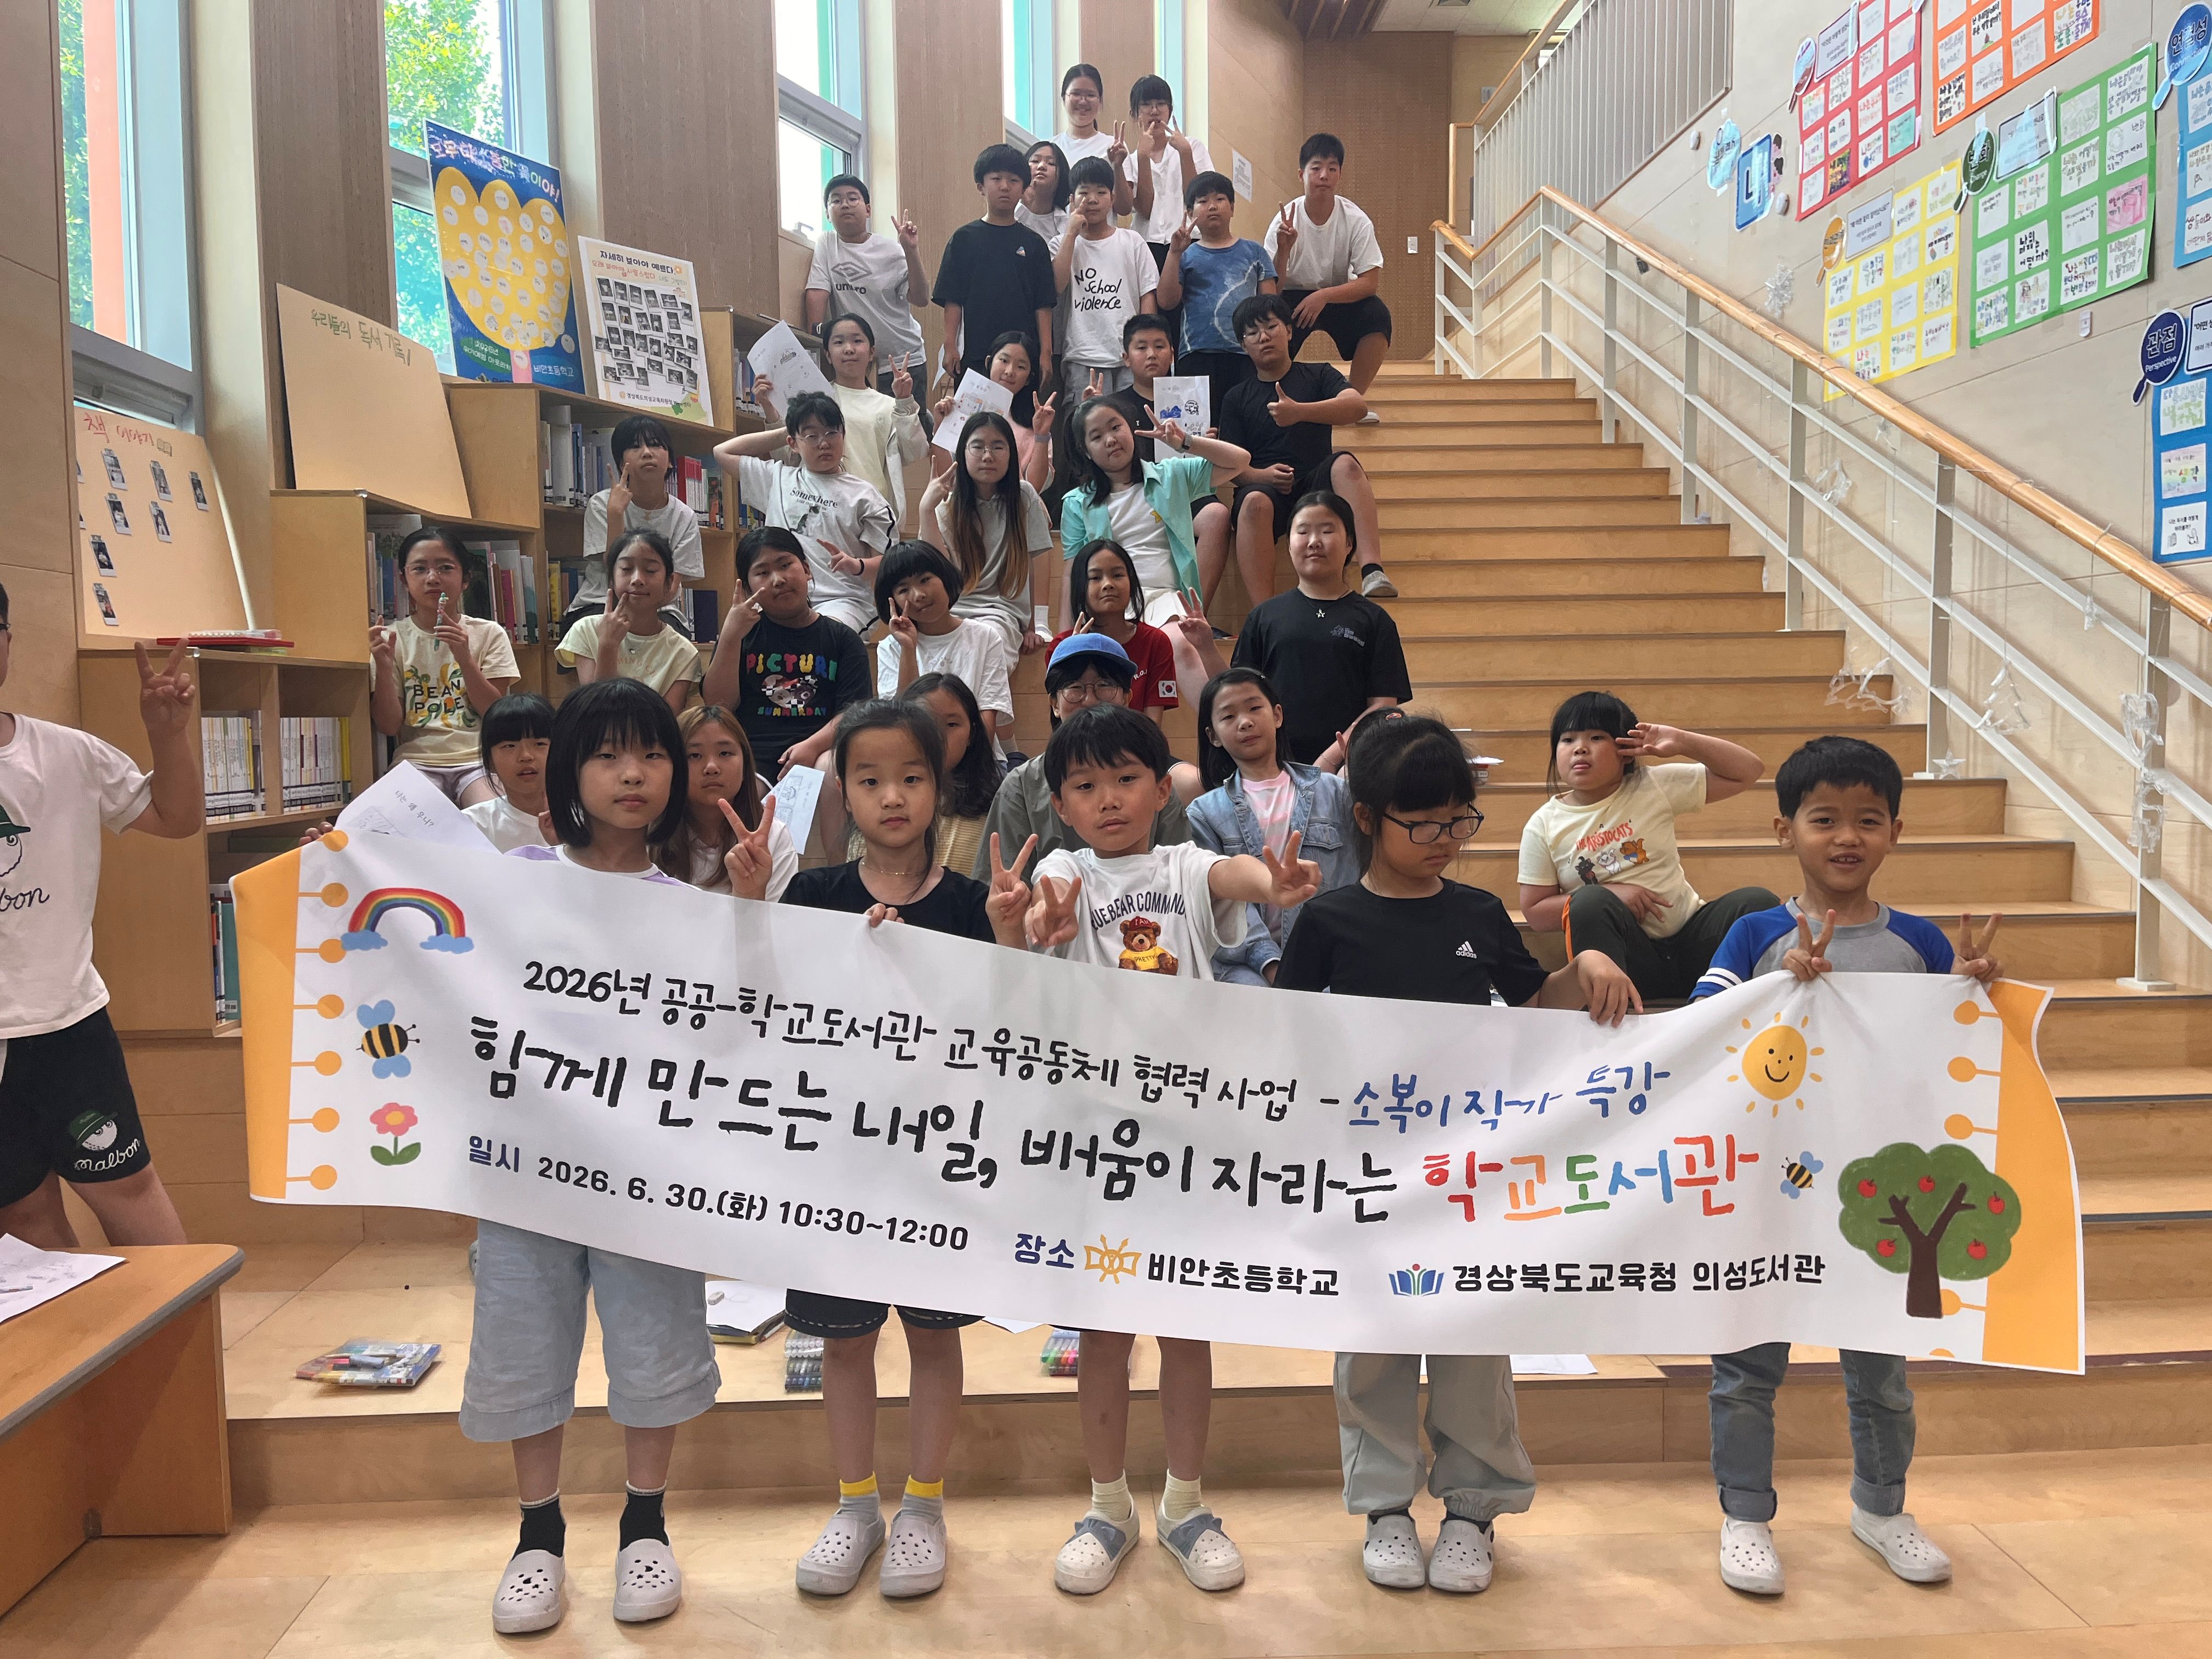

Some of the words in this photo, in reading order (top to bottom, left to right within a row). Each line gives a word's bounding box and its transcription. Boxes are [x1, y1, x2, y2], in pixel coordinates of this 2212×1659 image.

[600, 250, 624, 263] 자세히
[626, 256, 650, 268] 보아야
[836, 283, 867, 295] umro
[1074, 268, 1097, 285] NO
[311, 309, 352, 340] 우리들의
[358, 321, 383, 352] 독서
[2146, 323, 2177, 359] 관점
[2145, 356, 2177, 373] Perspective
[83, 412, 110, 443] 책
[116, 425, 155, 447] 이야기
[414, 679, 461, 698] BEAN
[415, 697, 464, 714] POLE
[1576, 838, 1587, 851] THE
[1107, 894, 1136, 922] BEAR
[1455, 950, 1477, 959] adidas
[523, 961, 651, 1015] 2026년
[661, 978, 937, 1062] 공공-학교도서관
[944, 1028, 1120, 1087] 교육공동체
[1133, 1054, 1210, 1109] 협력
[1217, 1077, 1297, 1122] 사업
[1348, 1073, 1451, 1134] 소복이
[1463, 1089, 1563, 1131] 작가
[1576, 1062, 1671, 1118] 특강
[471, 1015, 627, 1108] 함께
[648, 1058, 832, 1152] 만드는
[853, 1099, 997, 1189] 내일,
[1020, 1119, 1194, 1201] 배움이
[1212, 1151, 1397, 1223] 자라는
[1423, 1134, 1759, 1222] 학교도서관
[469, 1136, 520, 1173] 일시
[538, 1156, 616, 1196] 2026.
[628, 1177, 654, 1204] 6.
[665, 1183, 768, 1221] 30.(화)
[779, 1201, 968, 1250] 10:30~12:00
[1014, 1233, 1075, 1269] 장소
[1148, 1253, 1340, 1296] 비안초등학교
[1453, 1262, 1677, 1293] 경상북도교육청
[1692, 1254, 1826, 1291] 의성도서관
